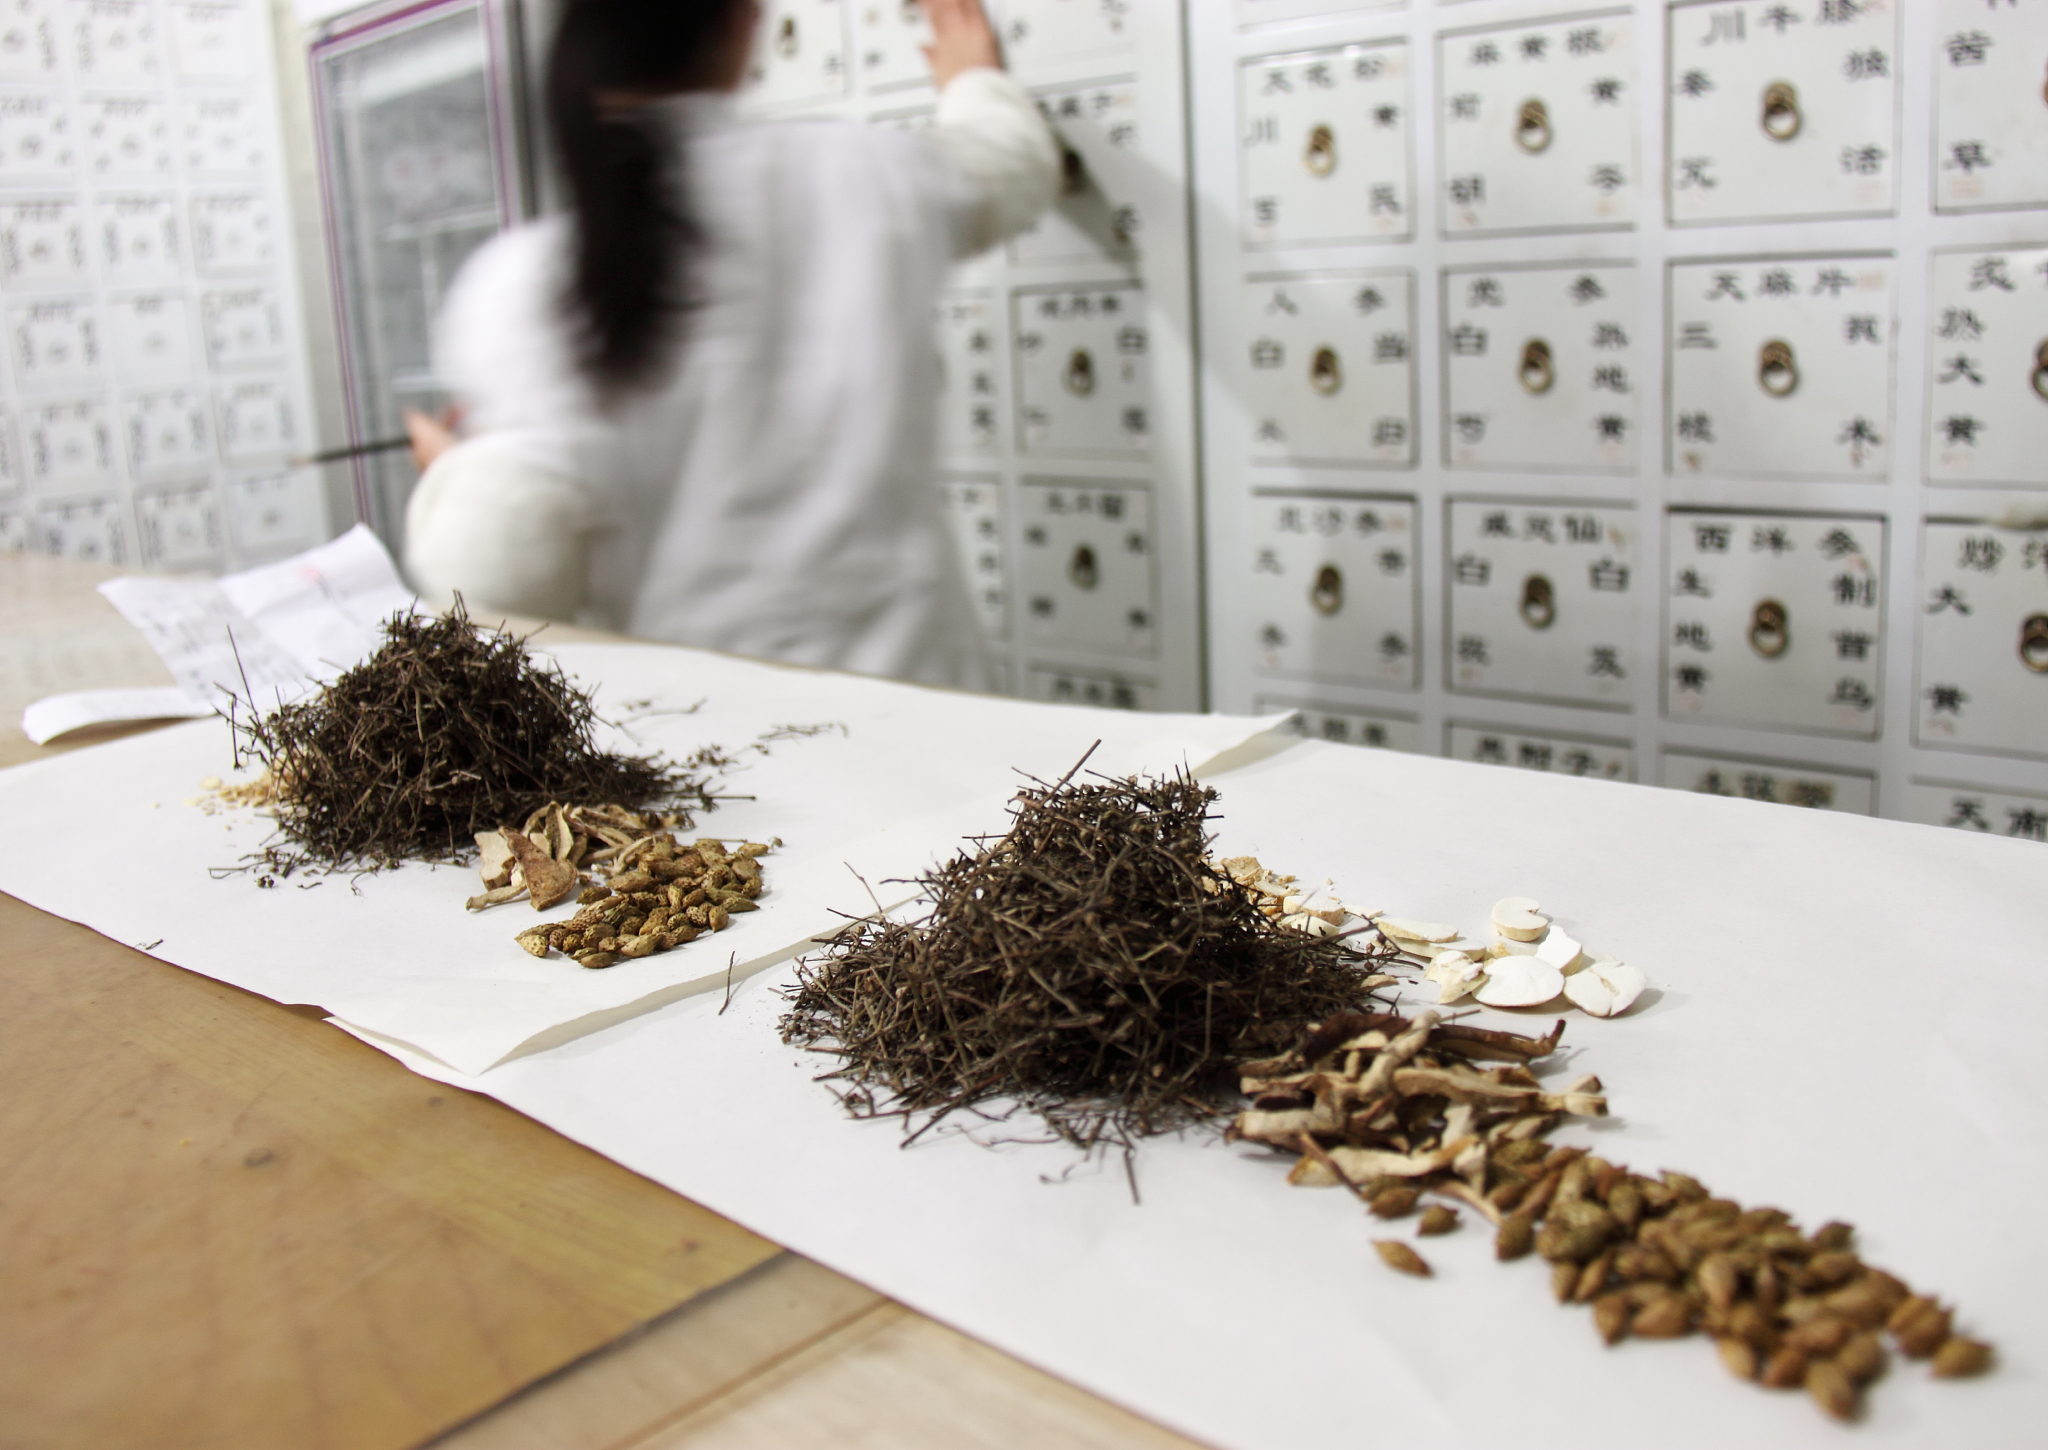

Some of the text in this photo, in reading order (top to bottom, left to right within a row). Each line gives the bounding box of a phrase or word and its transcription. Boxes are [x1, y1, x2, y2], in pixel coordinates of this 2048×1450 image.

[1694, 523, 1859, 558] 西洋参
[1926, 584, 1971, 714] 大黄
